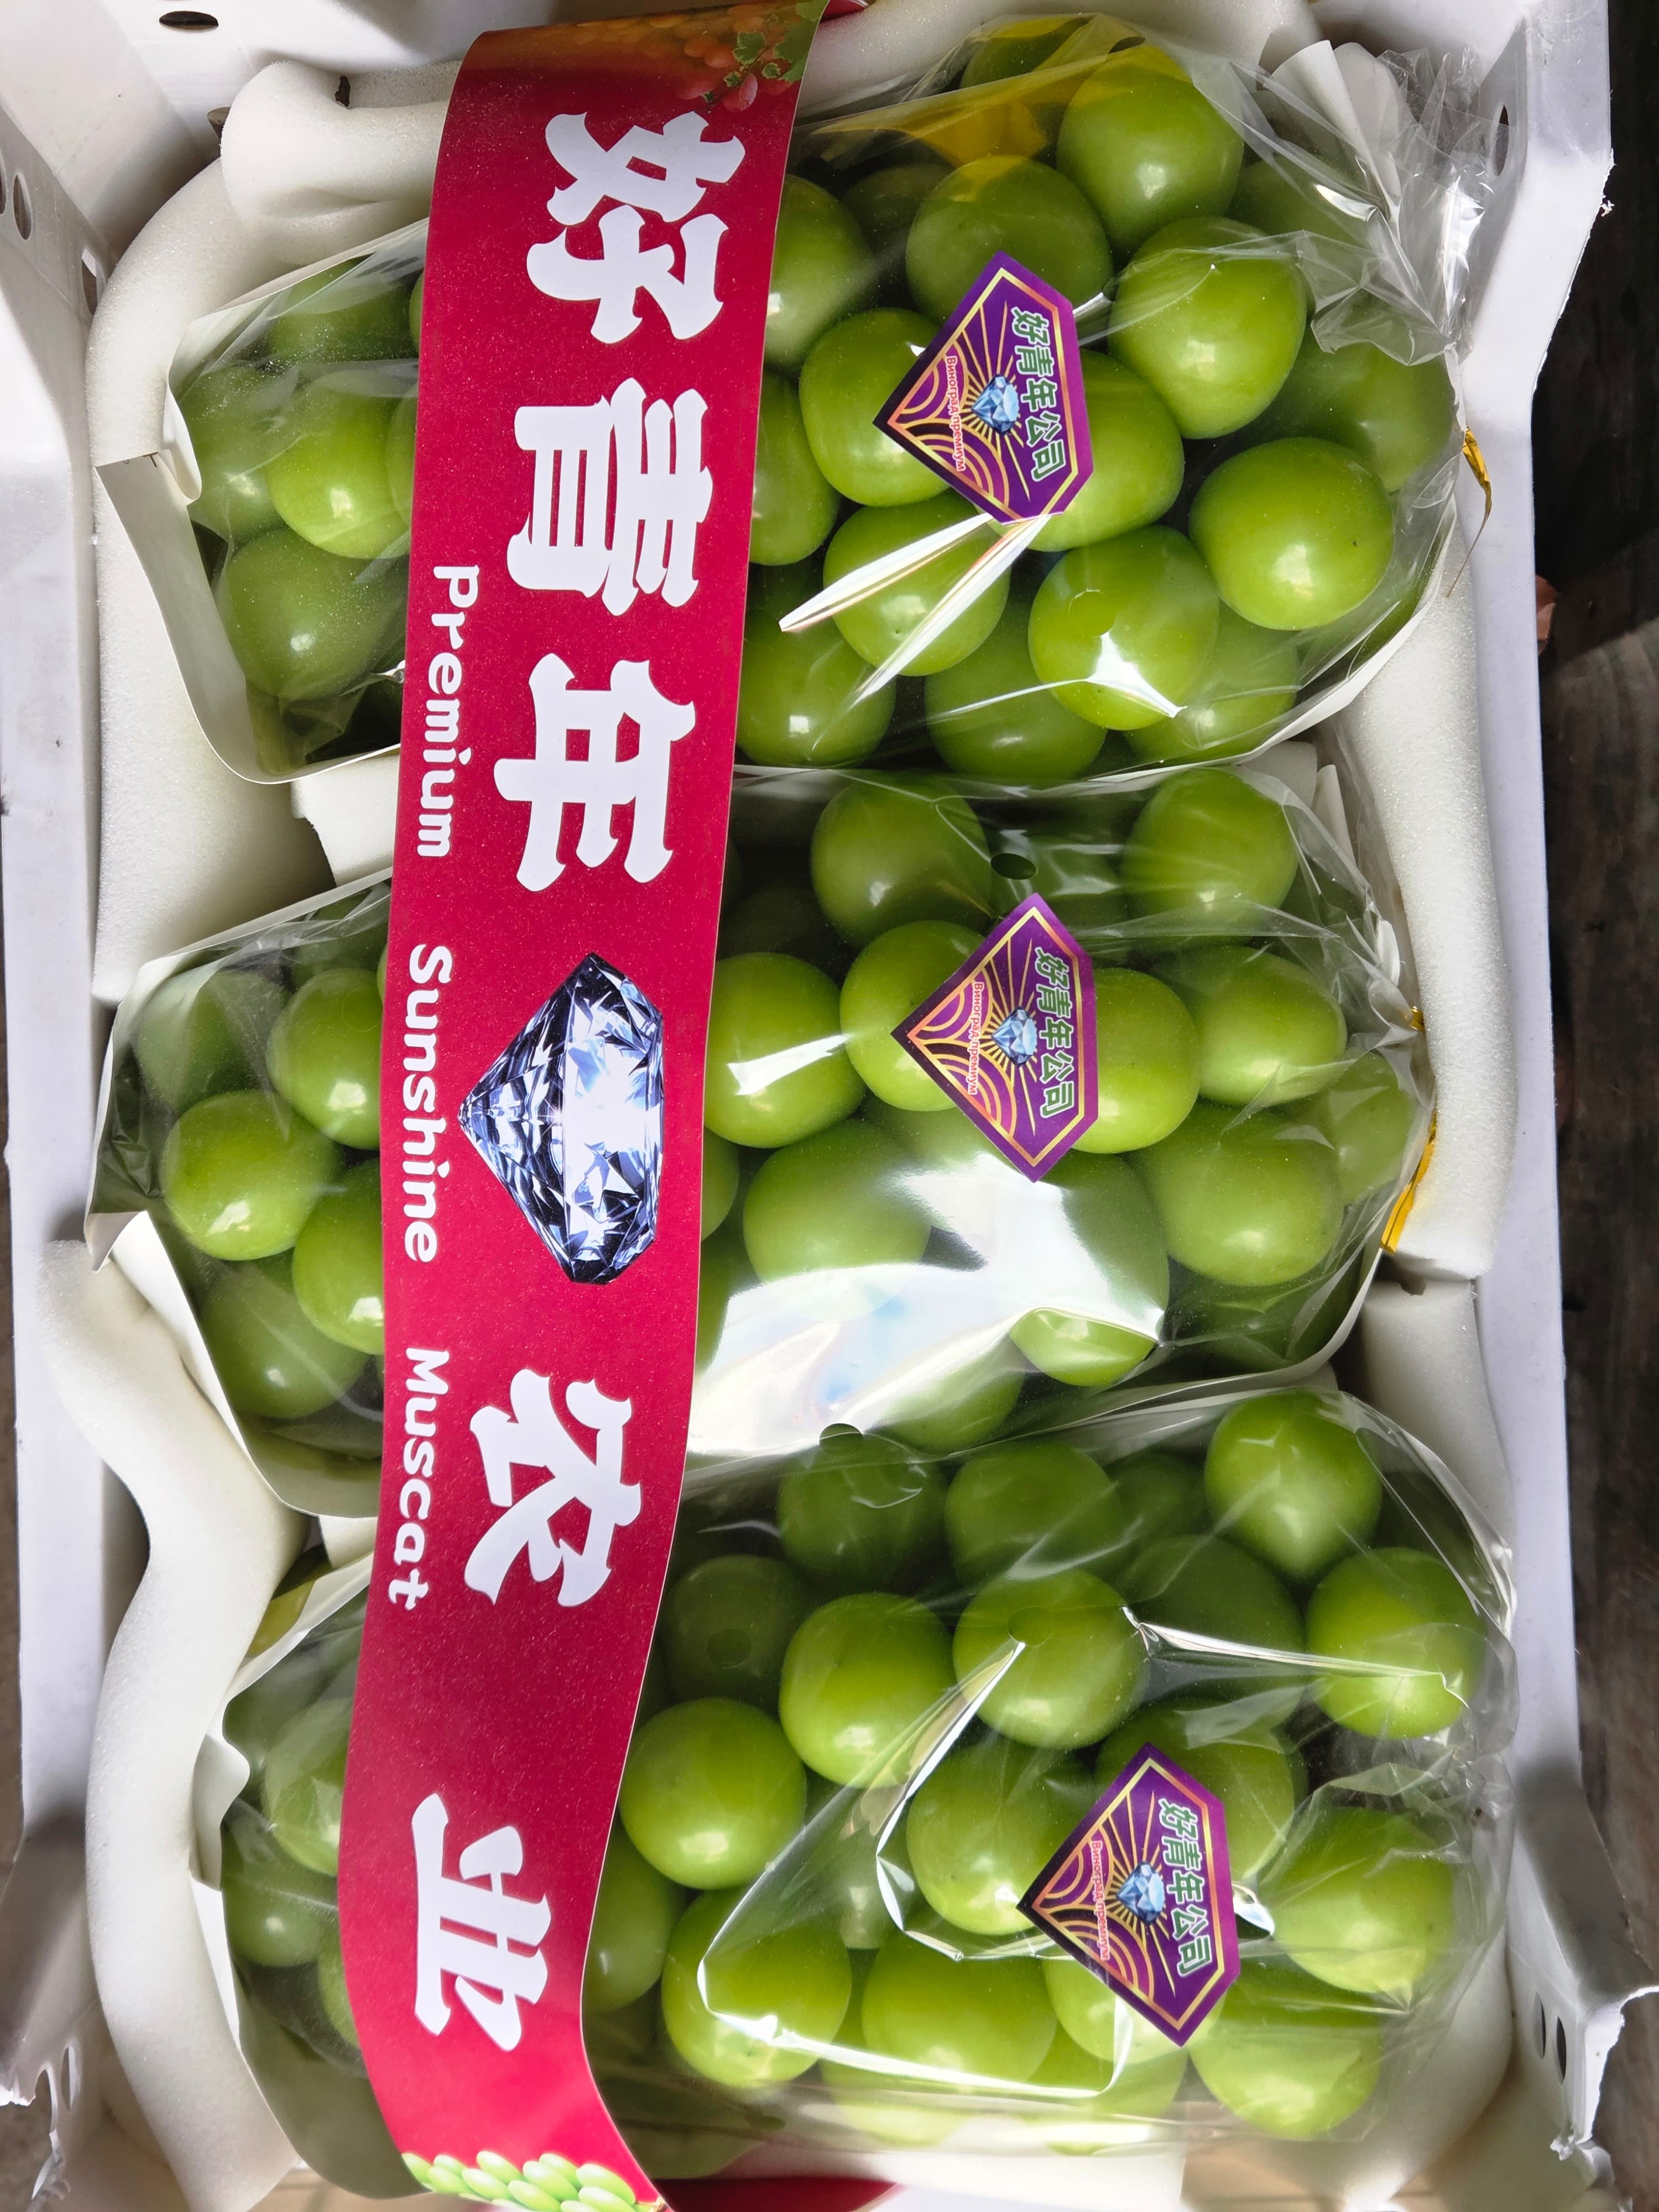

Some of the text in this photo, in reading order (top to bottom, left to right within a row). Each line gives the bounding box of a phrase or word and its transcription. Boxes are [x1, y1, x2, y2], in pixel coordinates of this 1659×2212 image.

[946, 356, 966, 472] Виноград премиум
[1011, 307, 1066, 482] 好青年公司
[388, 565, 480, 1610] Premium Sunshine Muscat
[411, 111, 745, 2052] 好青年 农业
[967, 982, 984, 1094] Виноград премиум
[1034, 947, 1075, 1118] 好青年公司
[1090, 1840, 1110, 1960] Виноград премиум
[1158, 1798, 1213, 1977] 好青年公司
